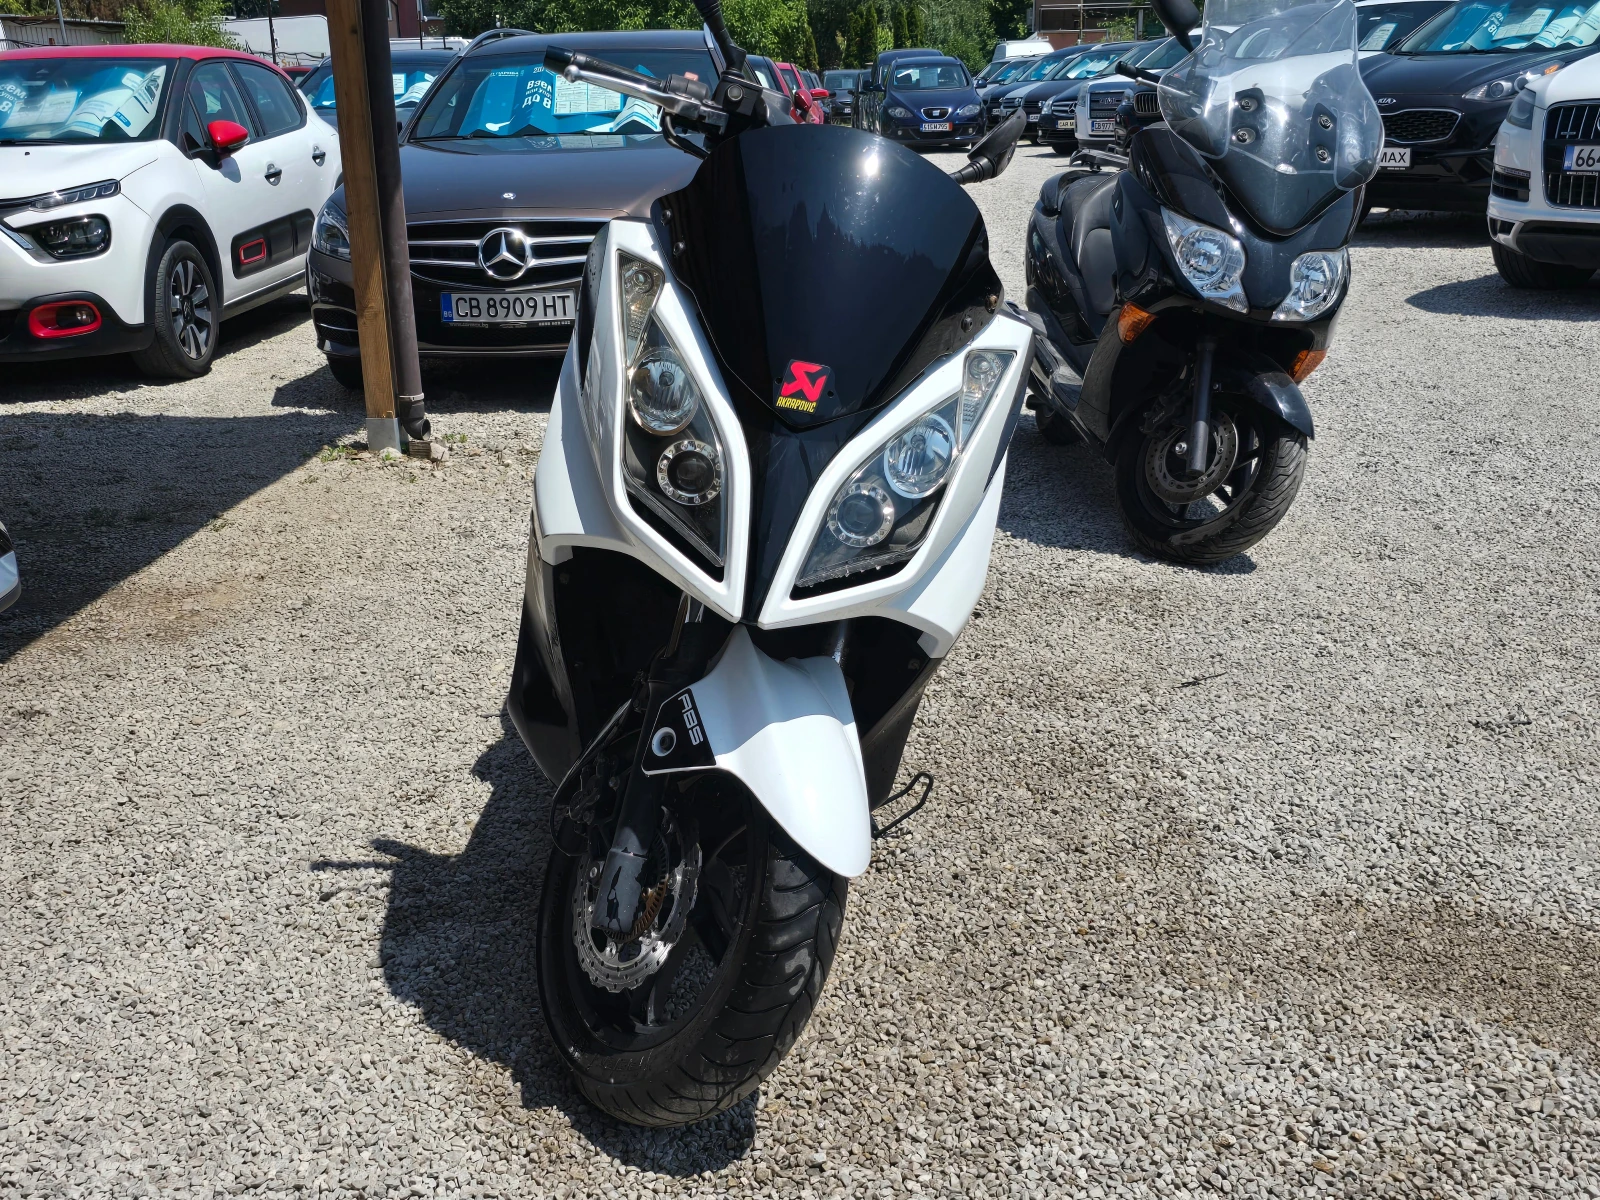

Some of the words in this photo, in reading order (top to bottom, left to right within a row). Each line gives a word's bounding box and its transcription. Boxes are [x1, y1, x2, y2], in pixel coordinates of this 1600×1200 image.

[455, 297, 482, 318] CB
[486, 296, 539, 318] 8909
[542, 294, 571, 317] HT
[677, 693, 704, 746] ABS
